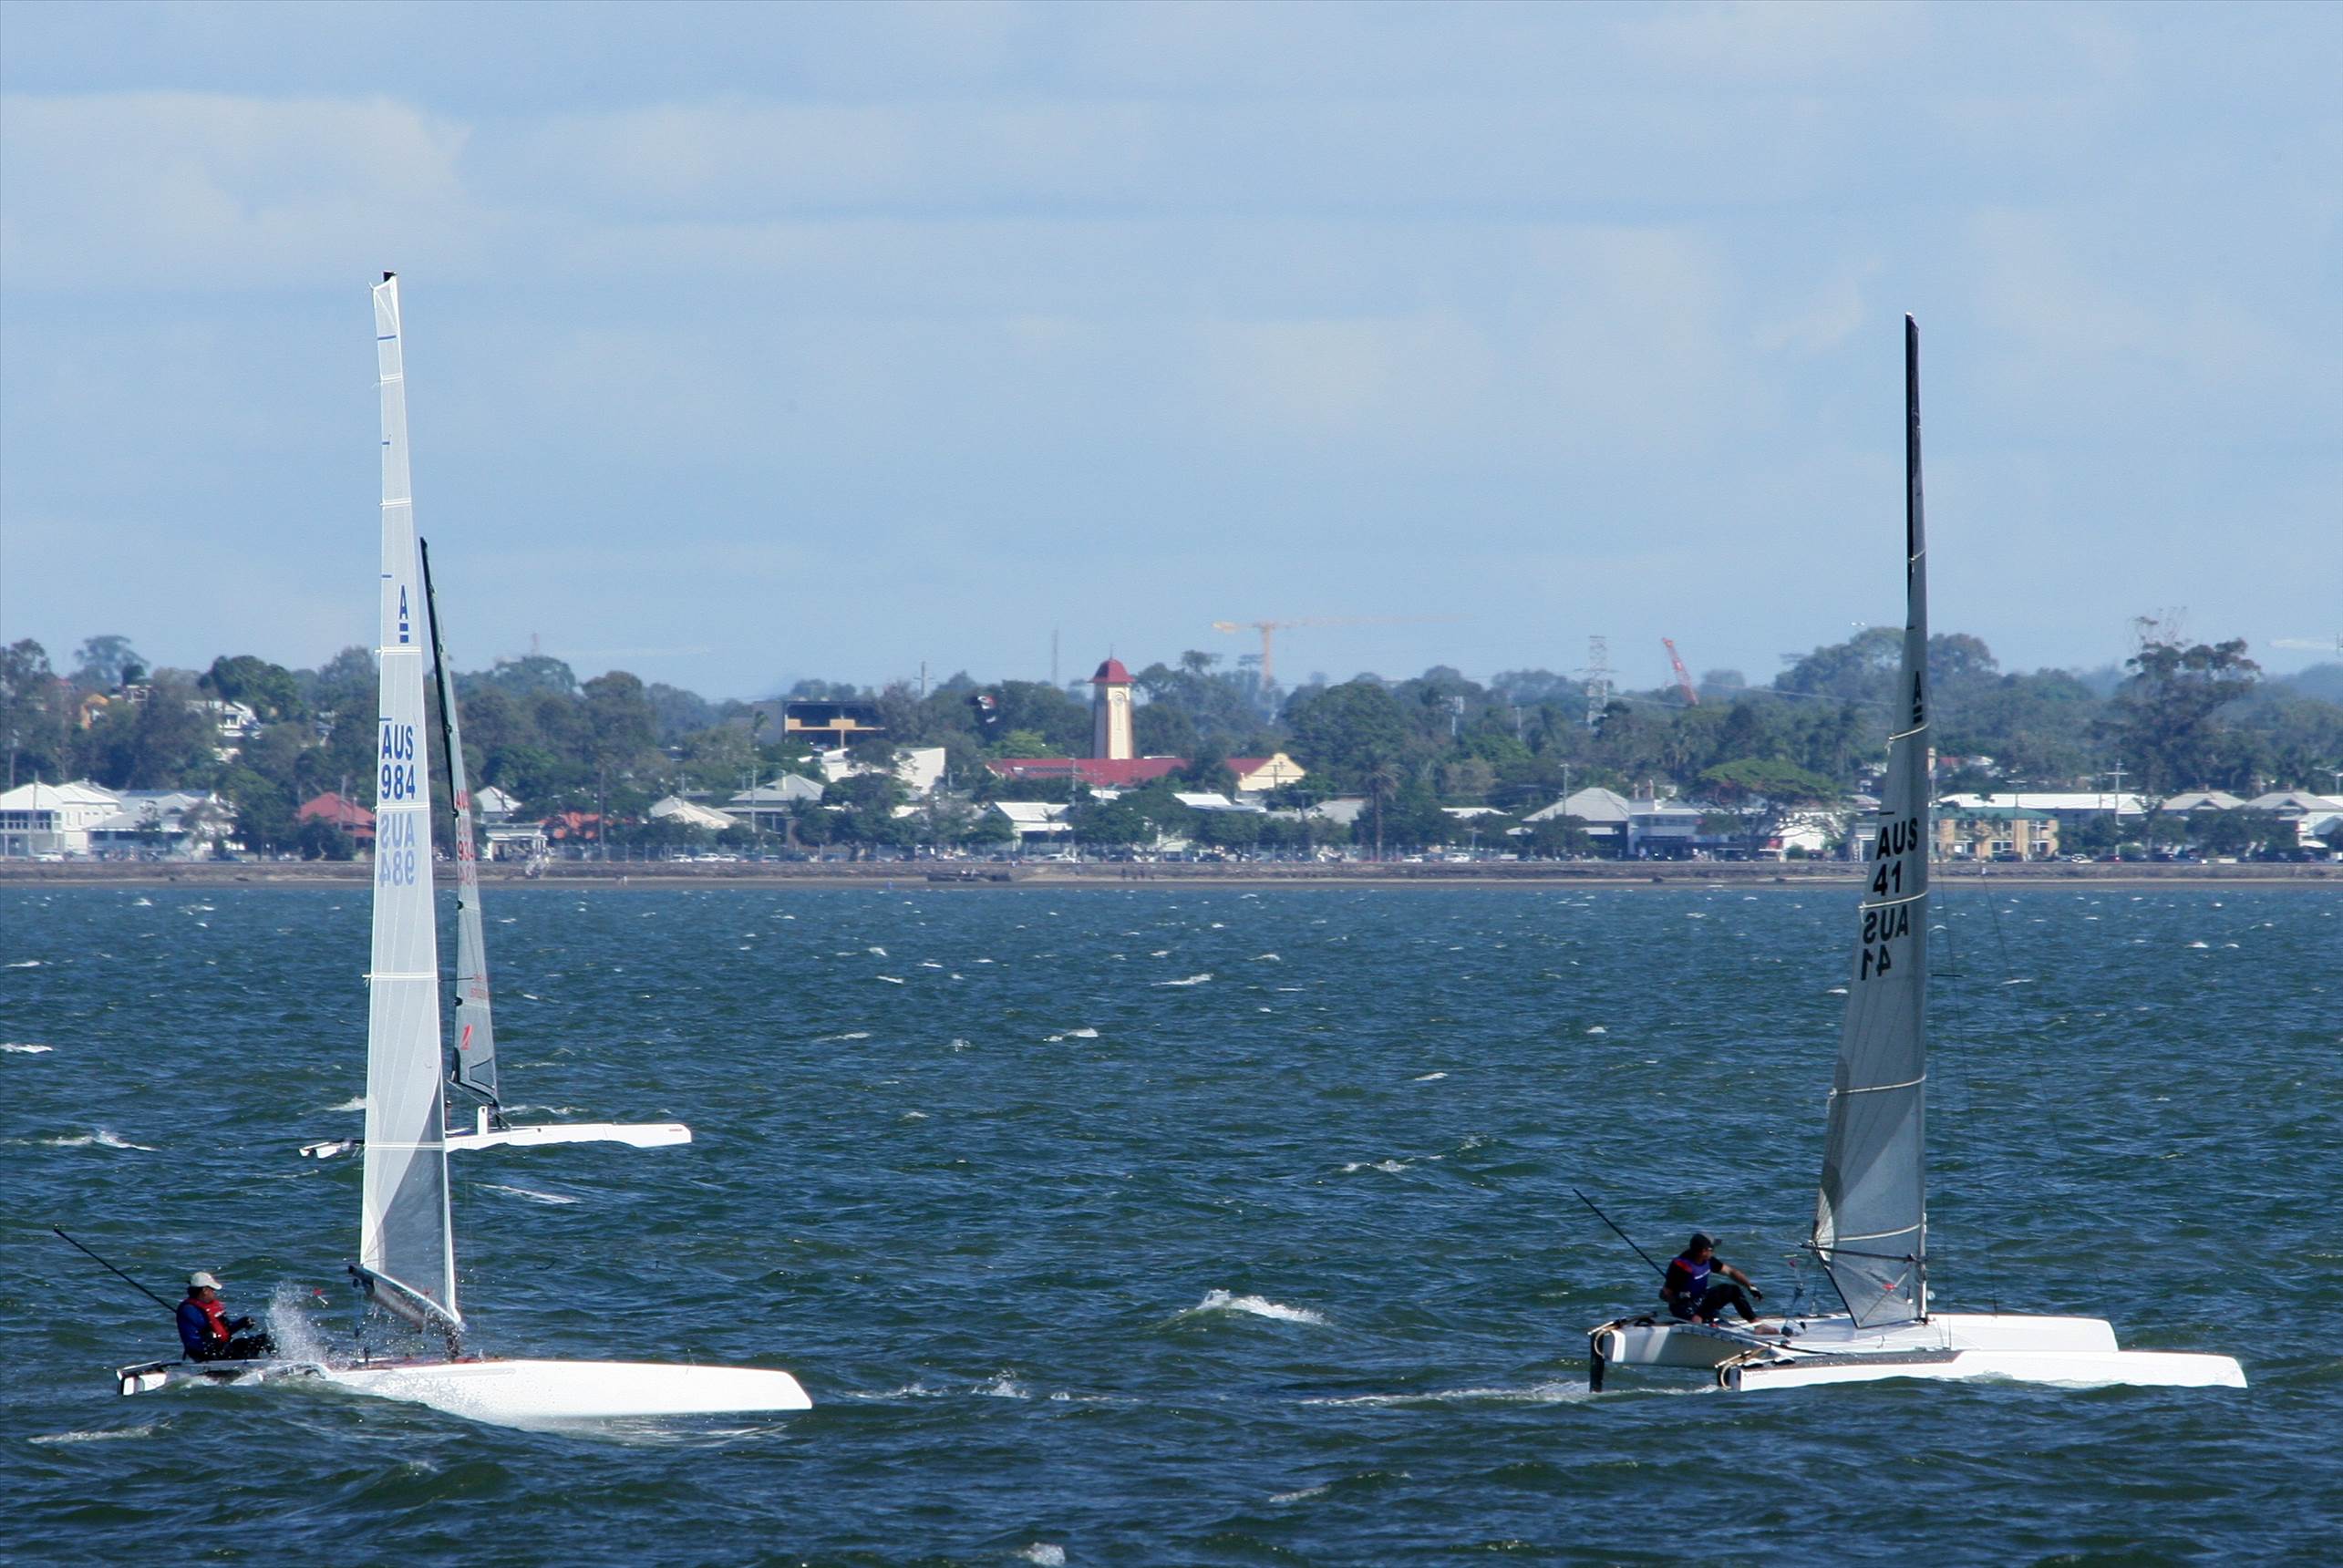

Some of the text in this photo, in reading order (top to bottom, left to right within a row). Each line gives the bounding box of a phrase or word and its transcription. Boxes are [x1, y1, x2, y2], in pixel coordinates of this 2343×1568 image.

[399, 584, 408, 620] A
[1913, 671, 1922, 705] A
[381, 725, 414, 761] AUS
[381, 764, 416, 800] 984
[1876, 818, 1918, 861] AUS
[1873, 861, 1902, 896] 41
